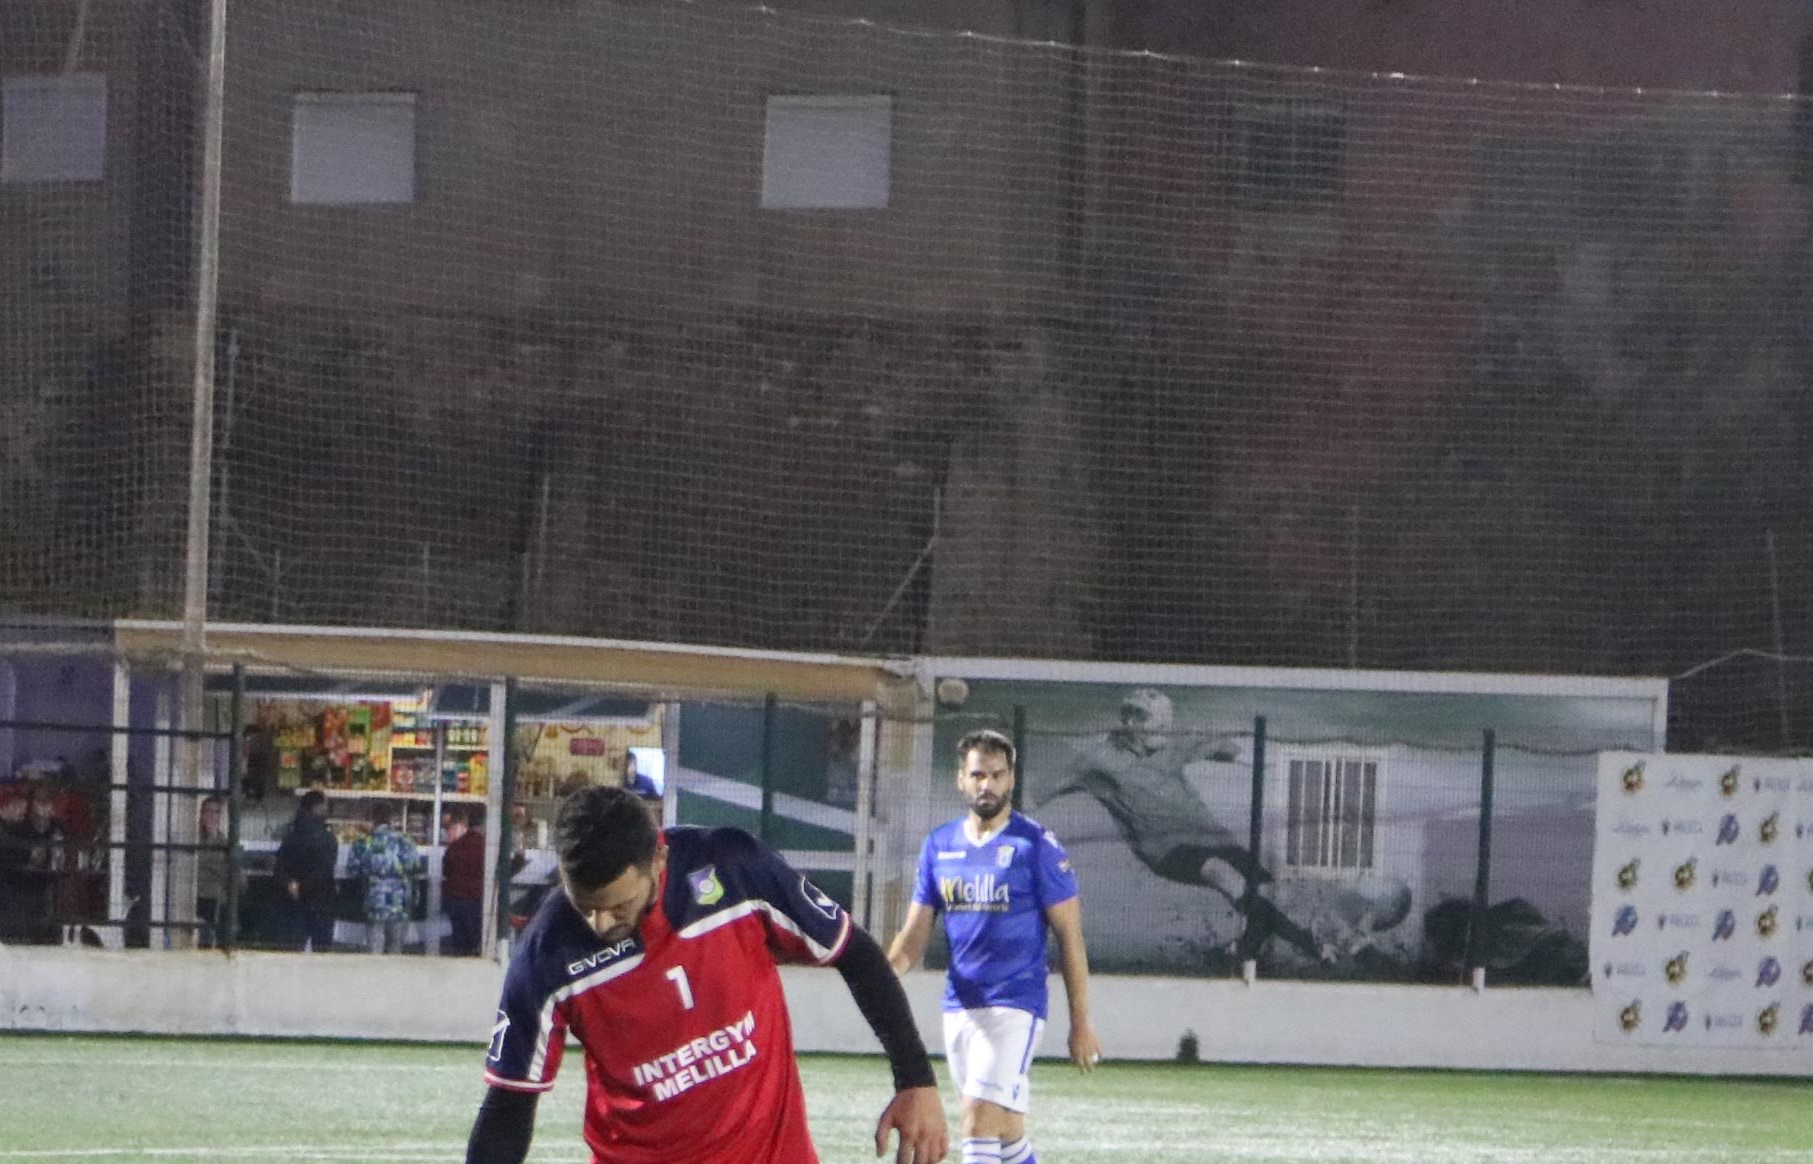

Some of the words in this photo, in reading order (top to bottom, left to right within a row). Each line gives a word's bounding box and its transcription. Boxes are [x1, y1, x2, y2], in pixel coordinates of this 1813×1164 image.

[940, 873, 1010, 903] Melilla
[568, 937, 636, 976] GIVOVA
[665, 964, 695, 1010] 1
[633, 1010, 755, 1086] INTERGYM
[651, 1039, 757, 1101] MELILLA
